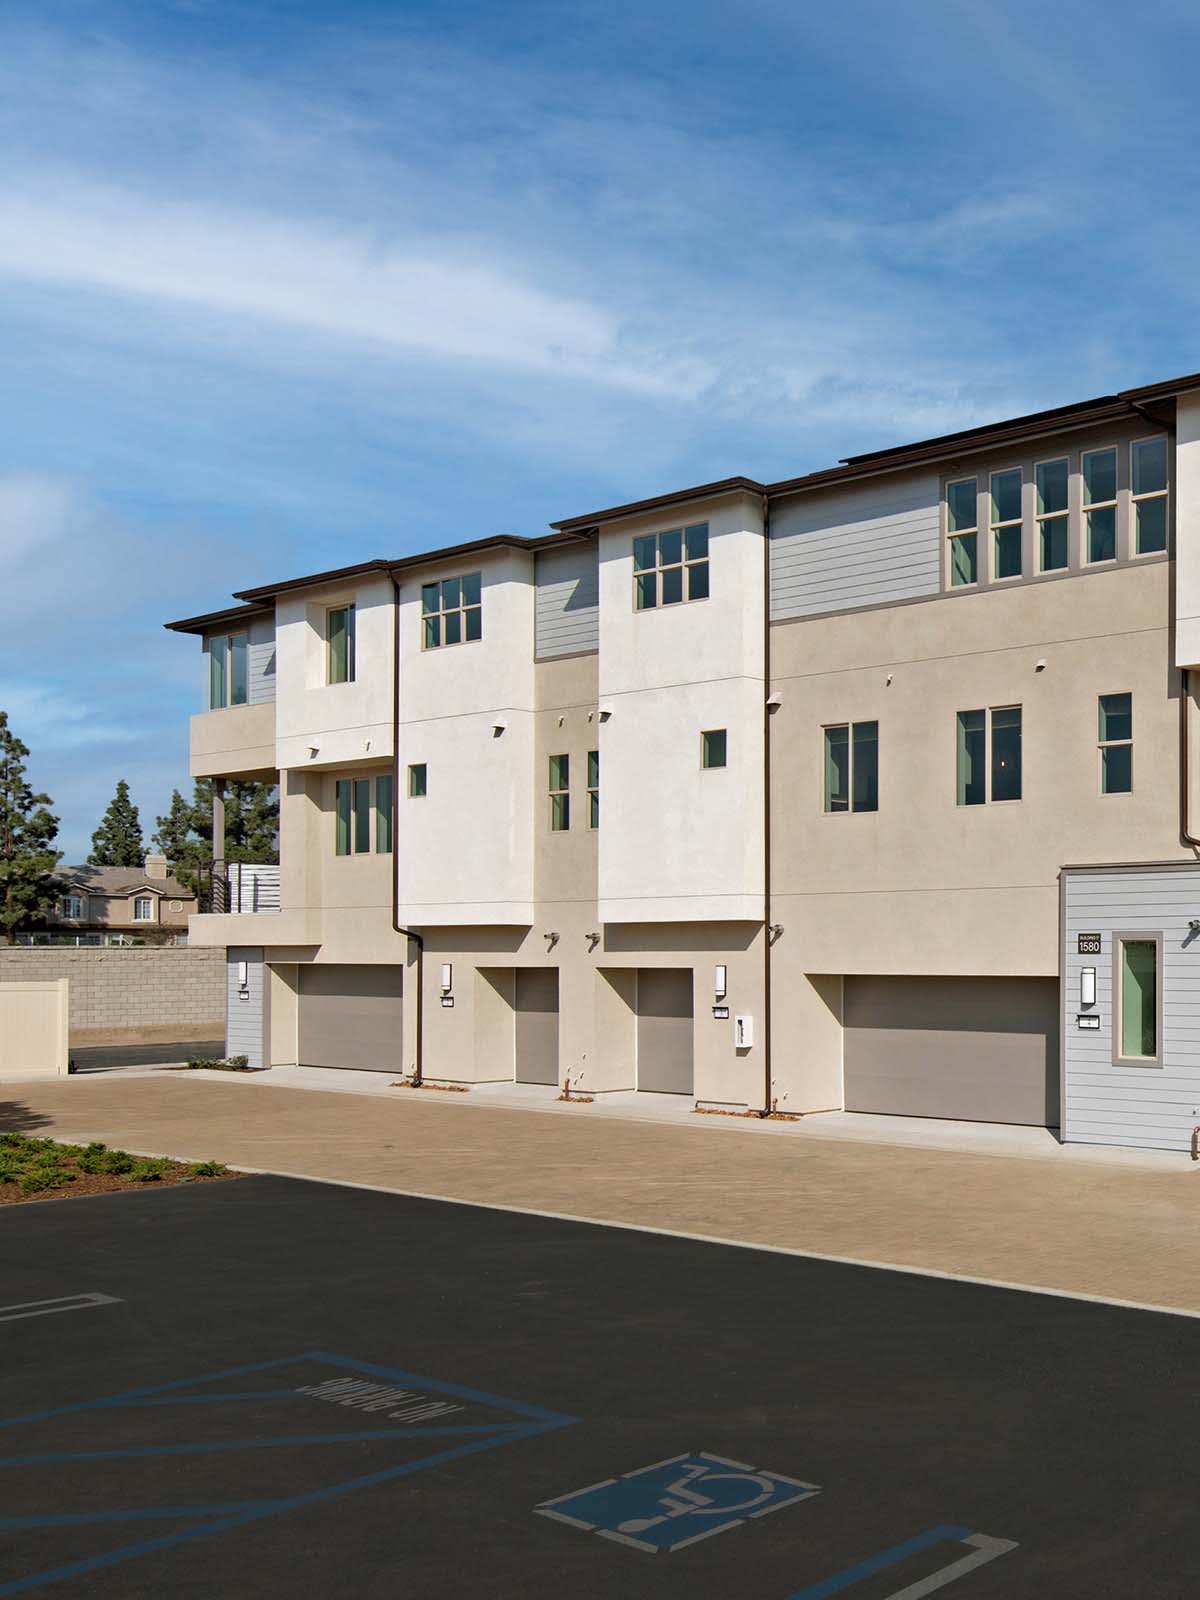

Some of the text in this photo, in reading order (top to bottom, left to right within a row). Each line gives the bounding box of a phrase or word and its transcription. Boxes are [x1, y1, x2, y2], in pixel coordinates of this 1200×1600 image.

[1080, 941, 1100, 952] 1580
[293, 1377, 466, 1424] NO PARKING
